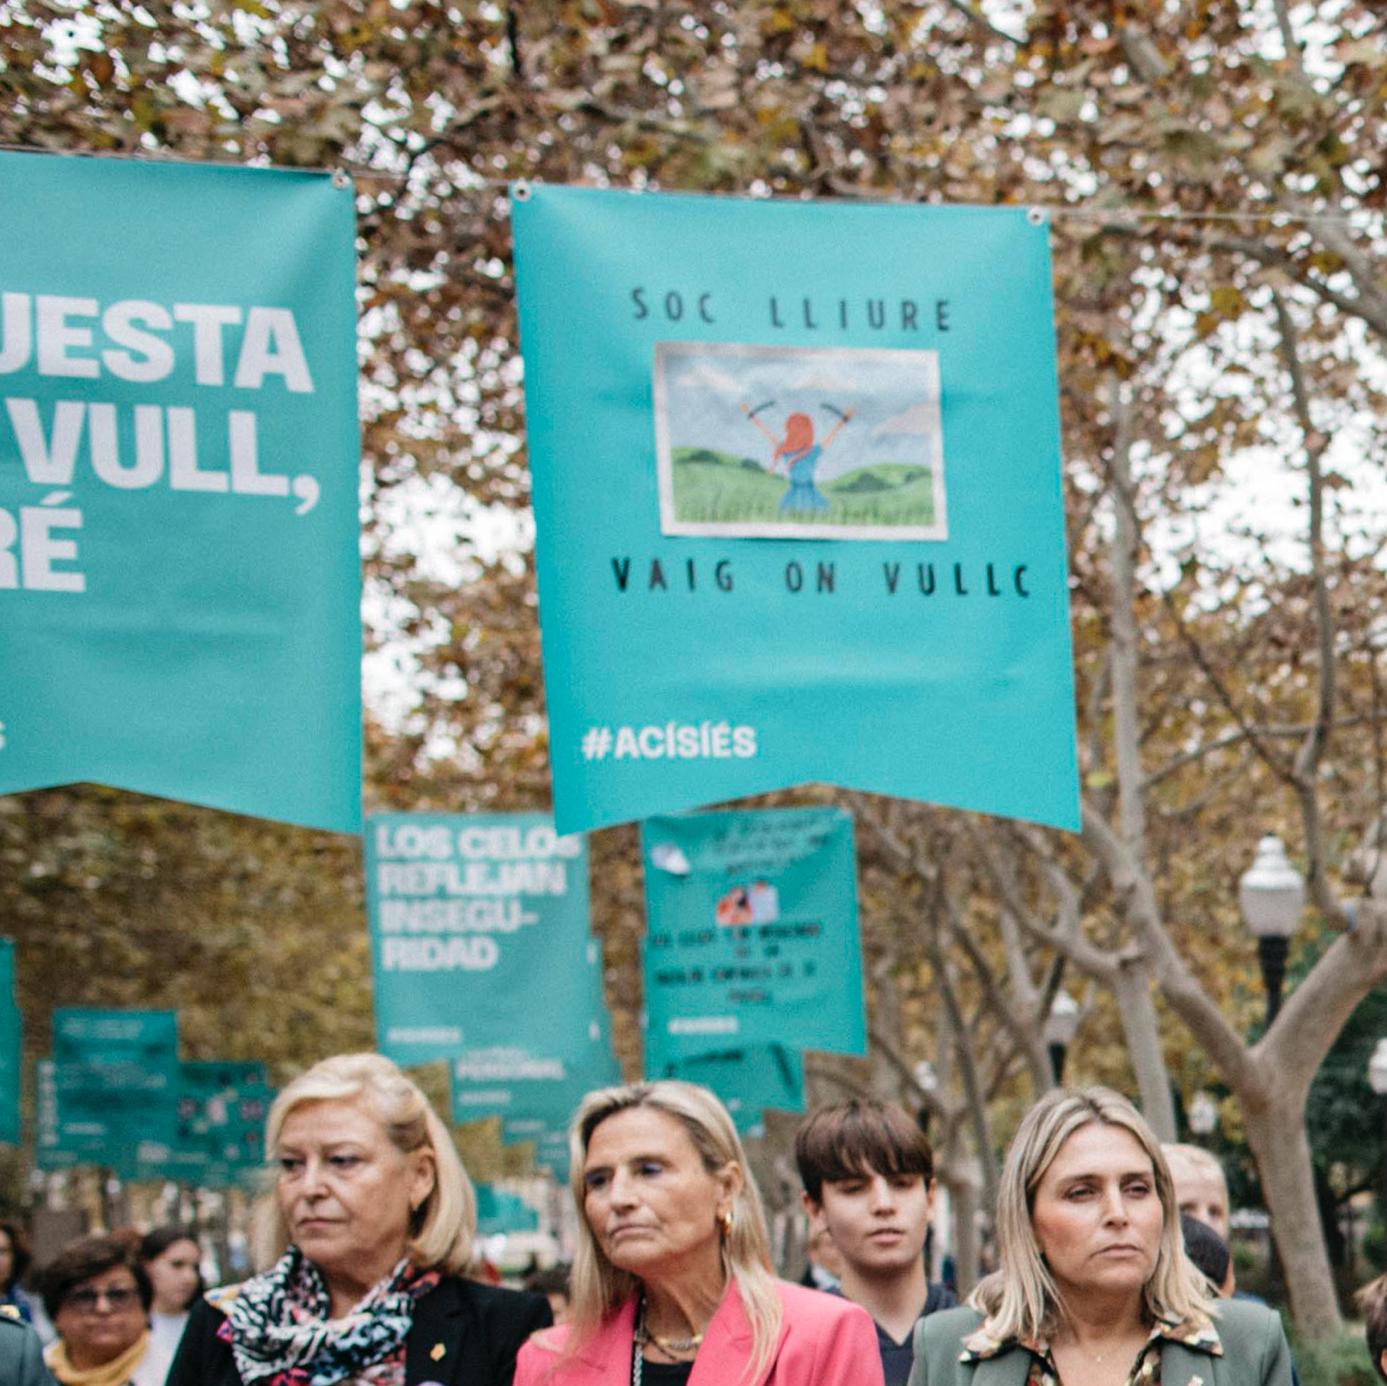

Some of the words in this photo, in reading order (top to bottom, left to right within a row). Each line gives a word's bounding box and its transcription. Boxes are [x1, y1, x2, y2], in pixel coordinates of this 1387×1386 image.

[629, 286, 716, 324] SOC
[769, 296, 952, 332] LLIURE
[6, 397, 321, 515] VULL,
[0, 490, 87, 593] É
[611, 557, 734, 593] VAIG
[784, 560, 836, 594] ON
[375, 824, 452, 858] LOS
[377, 861, 567, 896] REFLEJAN
[381, 935, 499, 971] RIDAD
